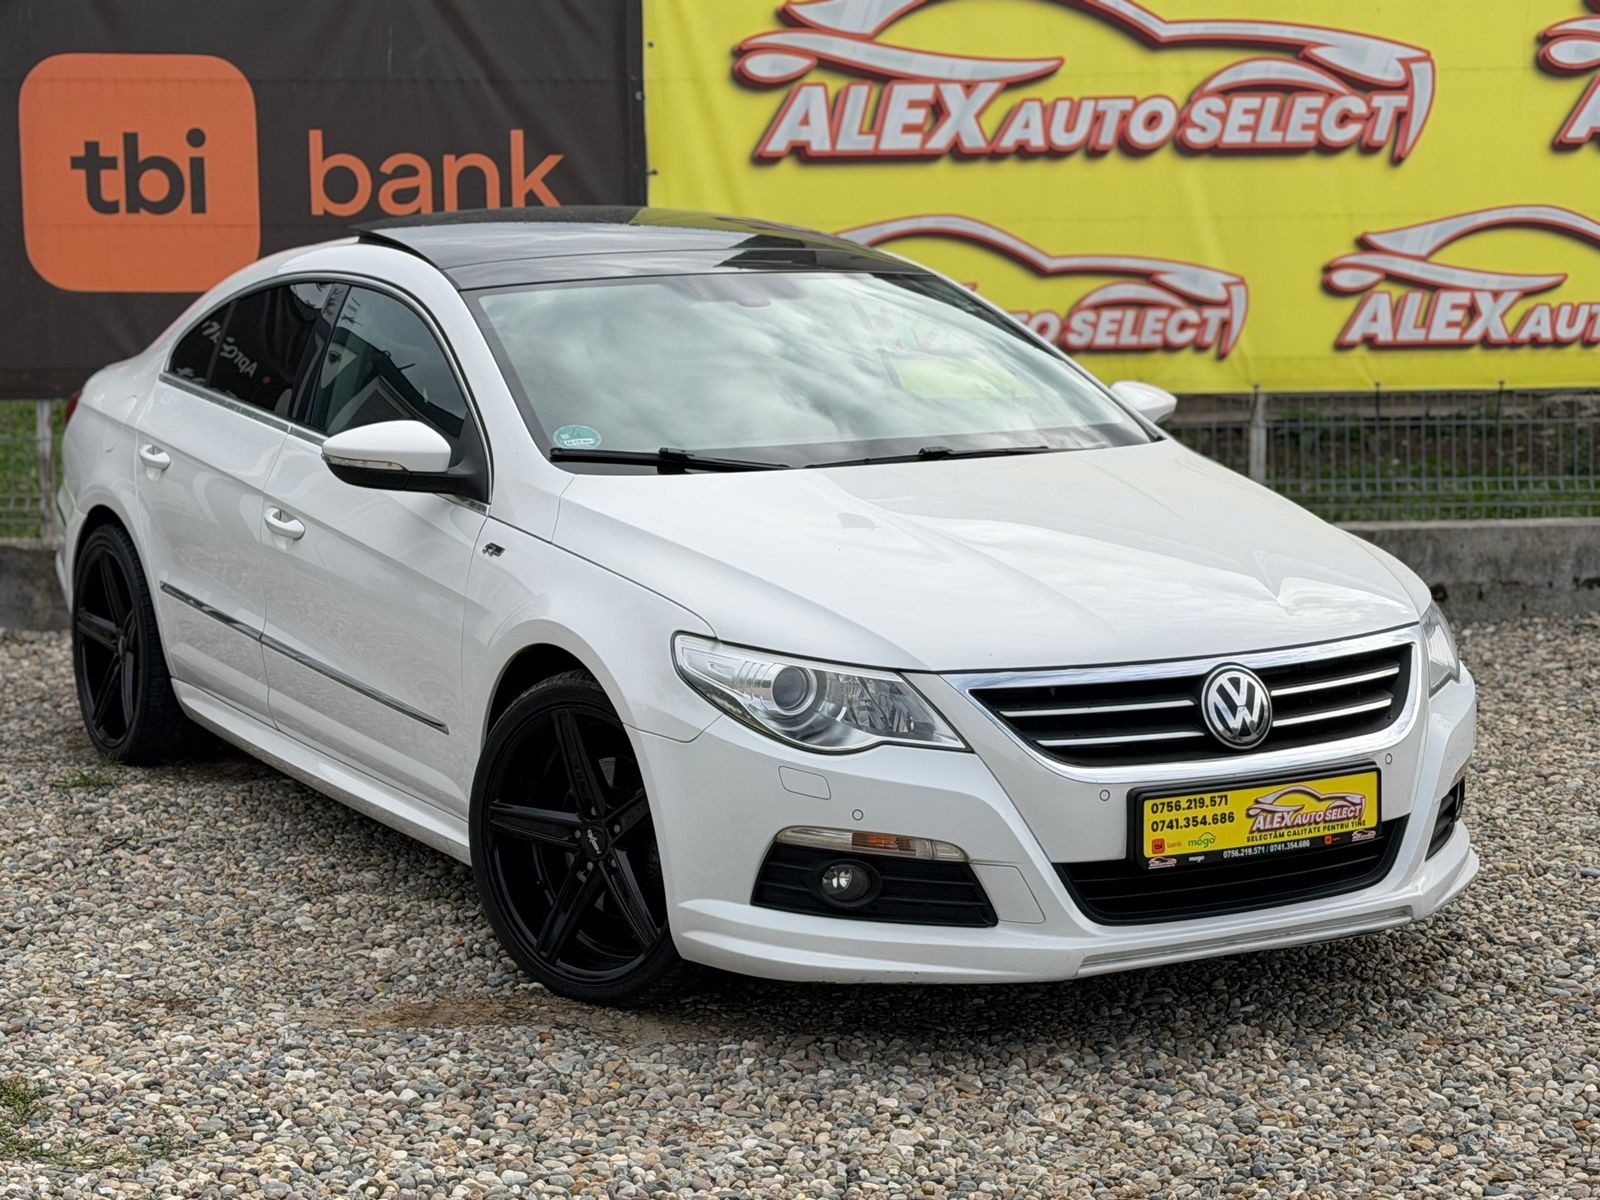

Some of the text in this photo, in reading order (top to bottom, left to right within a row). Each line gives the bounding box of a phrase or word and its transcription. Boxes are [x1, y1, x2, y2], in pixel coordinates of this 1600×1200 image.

[755, 80, 1409, 158] ALEX AUTO SELECT
[70, 127, 564, 217] tbi bank
[1064, 307, 1231, 350] SELECT
[1336, 290, 1523, 347] ALEX
[1151, 794, 1228, 814] 0756.219.571
[1151, 811, 1235, 832] 0741.354.686
[1251, 804, 1362, 832] ALEX AUTO SELECT
[1286, 827, 1321, 837] CALITATE
[1322, 822, 1349, 832] PENTRU
[1187, 837, 1216, 849] mogo
[1222, 845, 1265, 859] 0756.219.571
[1269, 839, 1311, 853] 0741.354.686
